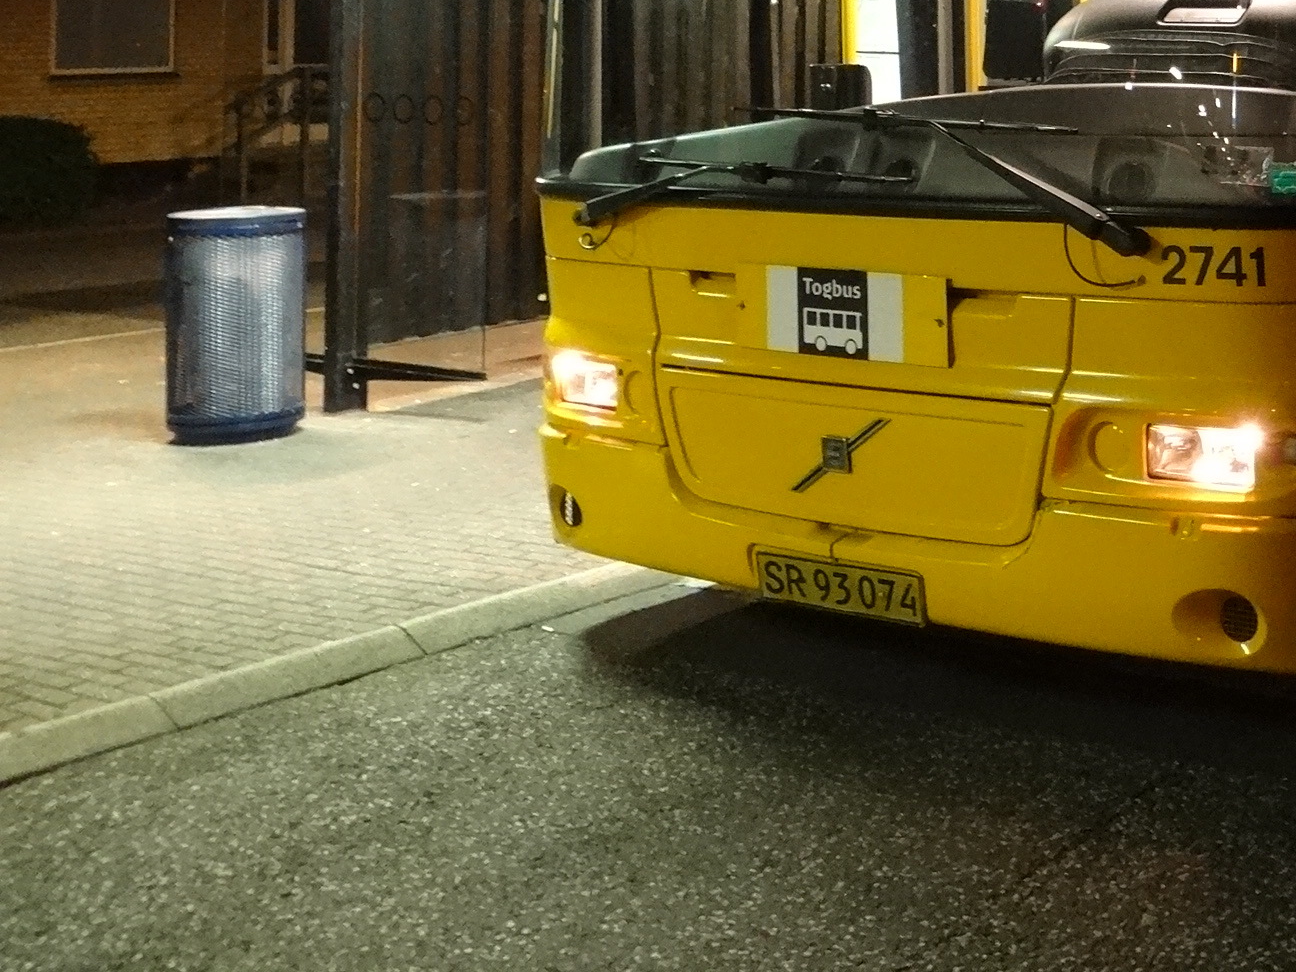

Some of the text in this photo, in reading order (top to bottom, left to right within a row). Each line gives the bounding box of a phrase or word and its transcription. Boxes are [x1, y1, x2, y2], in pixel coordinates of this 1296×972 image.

[1161, 245, 1267, 287] 2741
[802, 277, 862, 300] Togbus
[764, 561, 919, 618] SR 93 074
